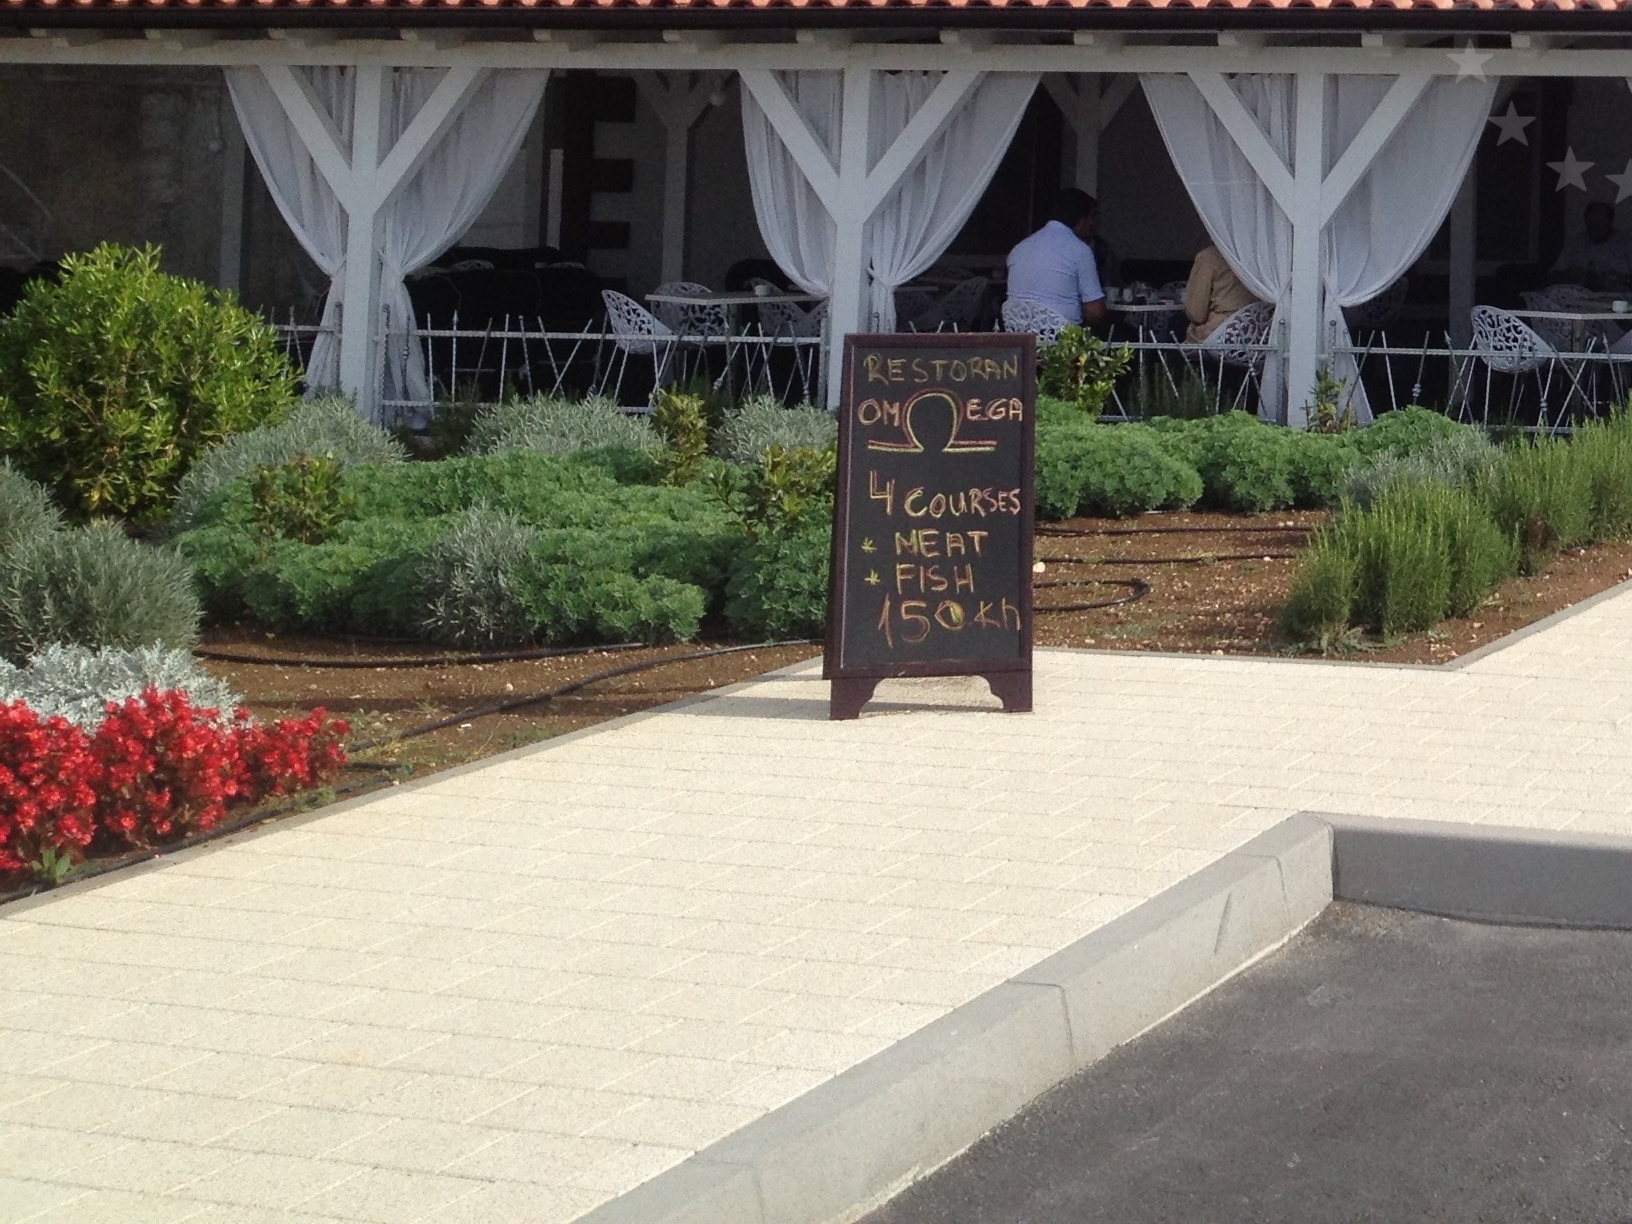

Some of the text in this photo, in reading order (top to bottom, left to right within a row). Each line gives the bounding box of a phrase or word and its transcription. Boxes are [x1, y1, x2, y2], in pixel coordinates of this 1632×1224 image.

[863, 352, 1019, 385] RESTORAN
[869, 469, 1022, 518] 4 COURSES
[894, 529, 989, 558] MEAT
[895, 563, 974, 595] FISH
